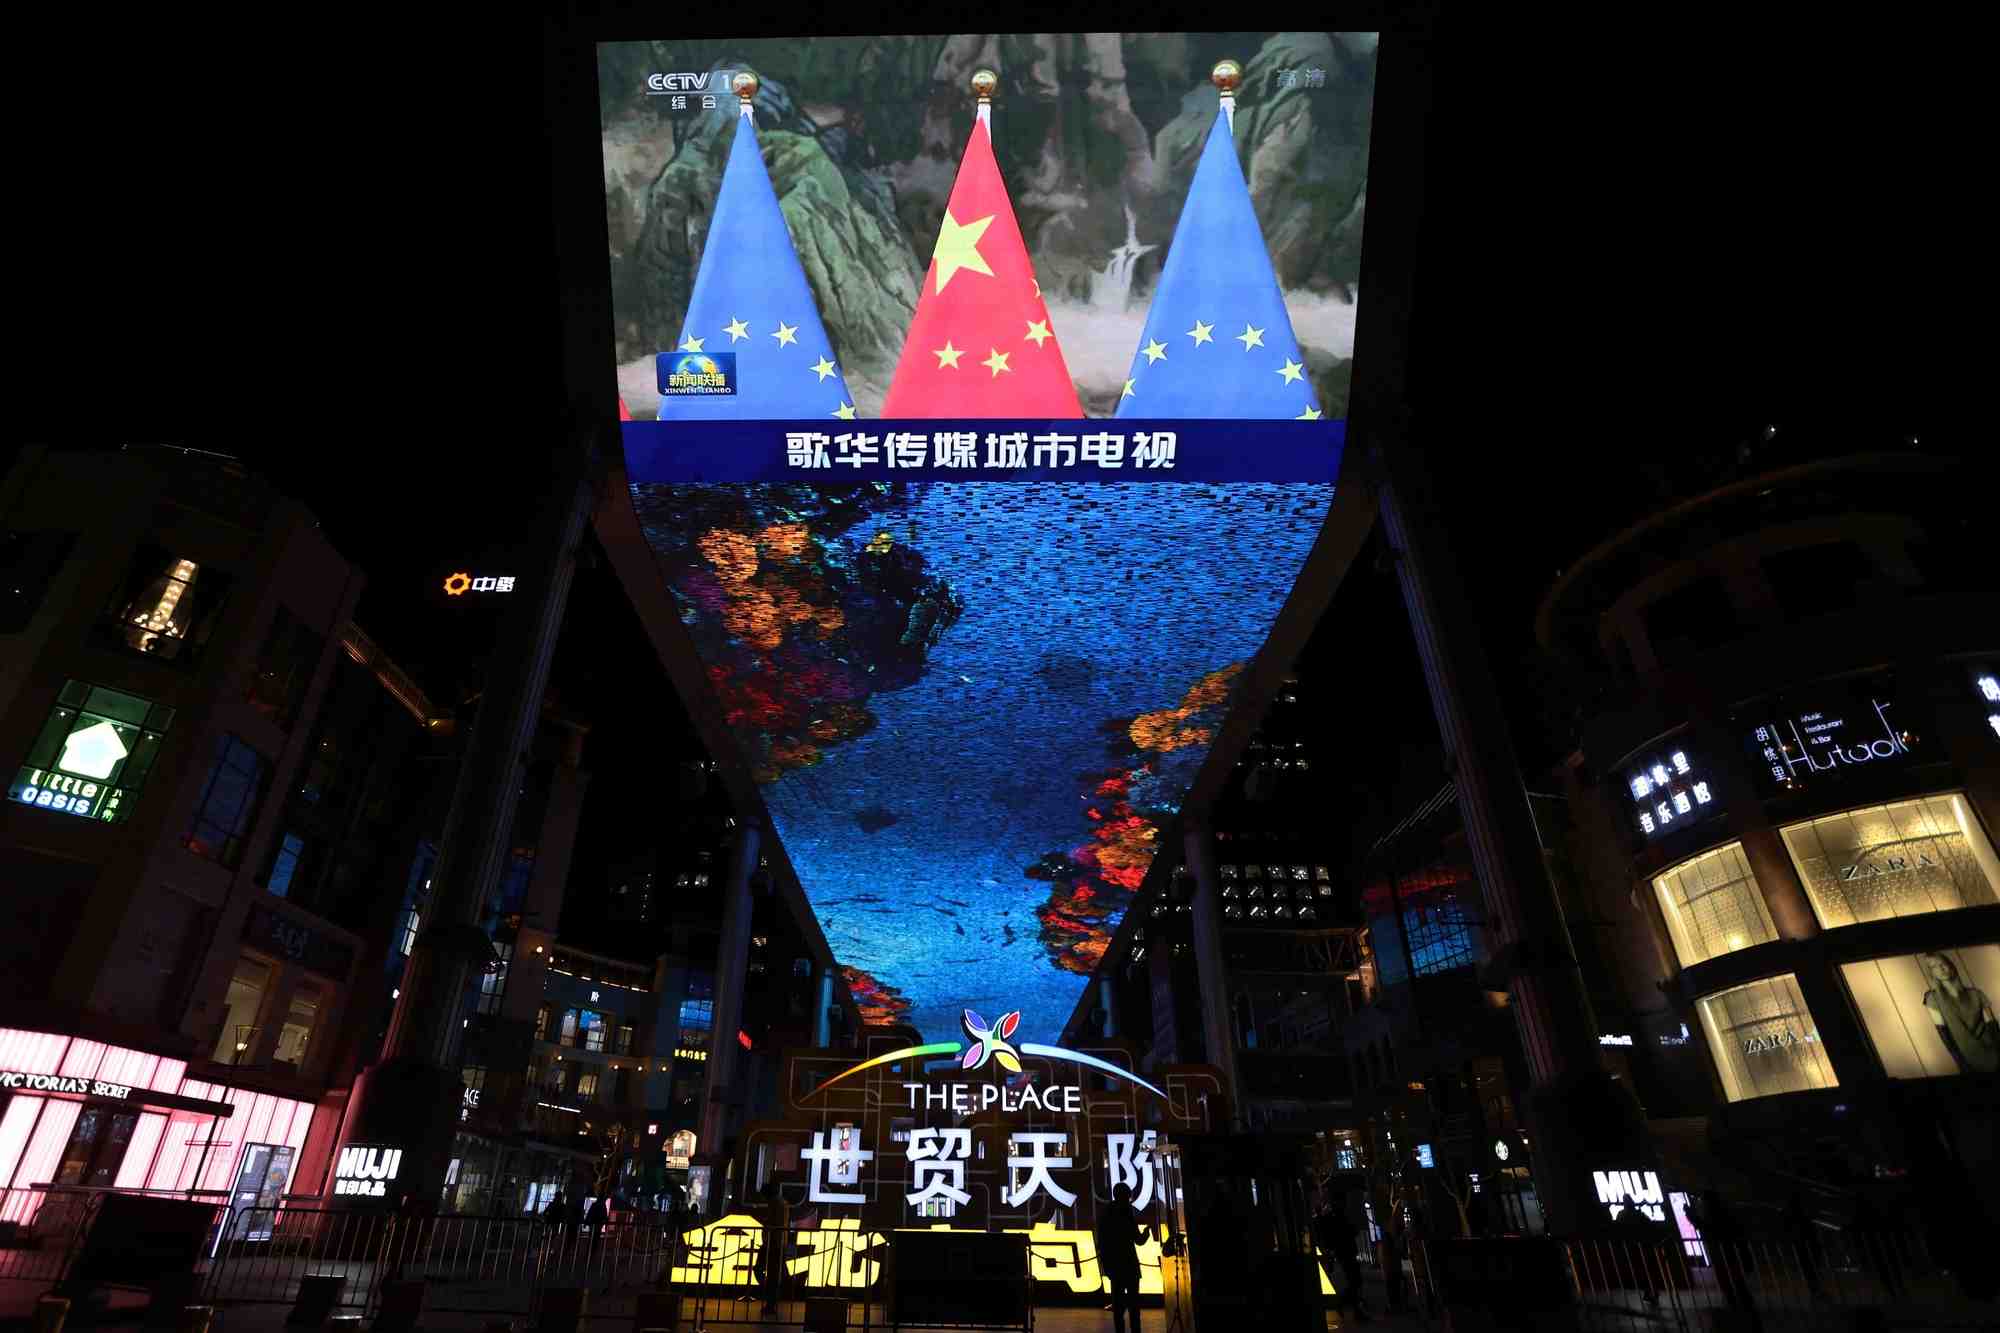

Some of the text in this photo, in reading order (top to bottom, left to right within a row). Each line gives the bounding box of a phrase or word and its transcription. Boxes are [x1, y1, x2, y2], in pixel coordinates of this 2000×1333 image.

[648, 72, 708, 90] CCTV
[671, 96, 717, 110] 综合
[669, 371, 725, 387] 新闻联播
[786, 432, 1177, 469] 歌华传媒城市电视
[1840, 855, 1939, 881] ZARA
[1744, 1031, 1801, 1055] ZARA
[92, 1081, 131, 1100] SECRET
[903, 1083, 1081, 1113] THE PLACE
[336, 1147, 402, 1179] MUJI
[801, 1127, 1183, 1212] 世贸天阶
[1593, 1171, 1664, 1204] MUJI
